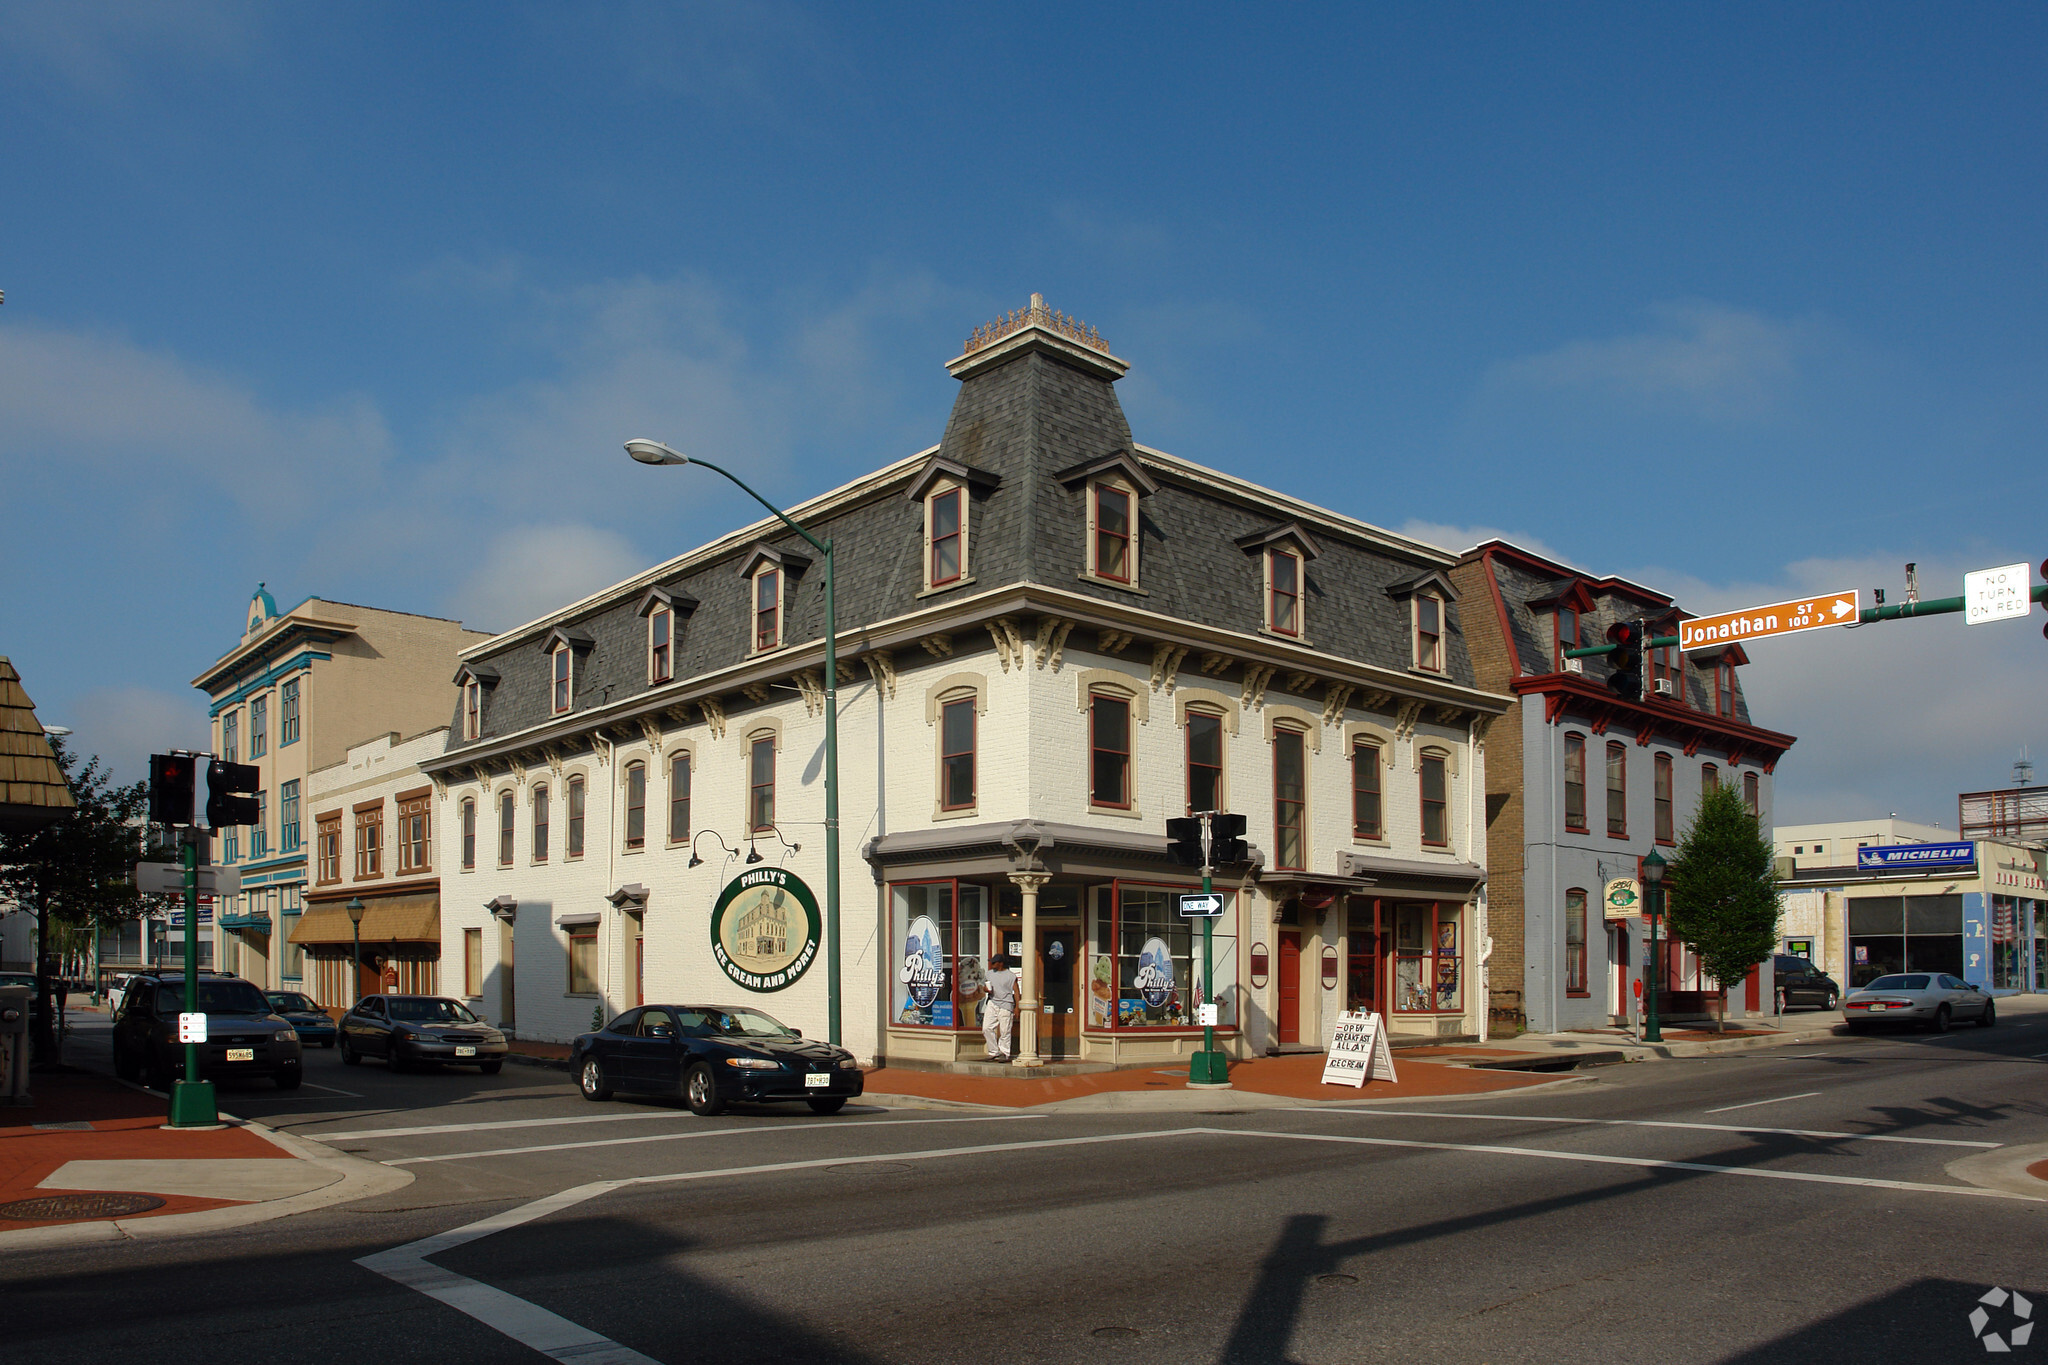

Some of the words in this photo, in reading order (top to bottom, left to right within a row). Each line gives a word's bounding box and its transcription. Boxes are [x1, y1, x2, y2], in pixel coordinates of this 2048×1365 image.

[1986, 574, 2007, 585] NO
[1979, 587, 2016, 600] TURN
[1971, 605, 1989, 617] ON
[1997, 599, 2024, 612] RED
[1682, 614, 1778, 645] Jonathan
[1796, 602, 1814, 615] ST
[1788, 615, 1809, 628] 100
[1886, 848, 1970, 861] MICHELIN
[741, 870, 787, 888] PHILLY'S
[1183, 901, 1194, 910] ONE
[1197, 901, 1209, 910] WAY
[714, 942, 728, 967] ICE
[727, 963, 761, 988] CREAM
[763, 973, 786, 988] AND
[787, 939, 816, 980] MORE!
[899, 949, 945, 984] Philly's
[1134, 963, 1175, 989] Philly's
[1343, 1024, 1365, 1032] OPEN
[1335, 1033, 1371, 1042] BREAKFAST
[1337, 1042, 1350, 1050] ALL
[1351, 1043, 1366, 1052] DAY
